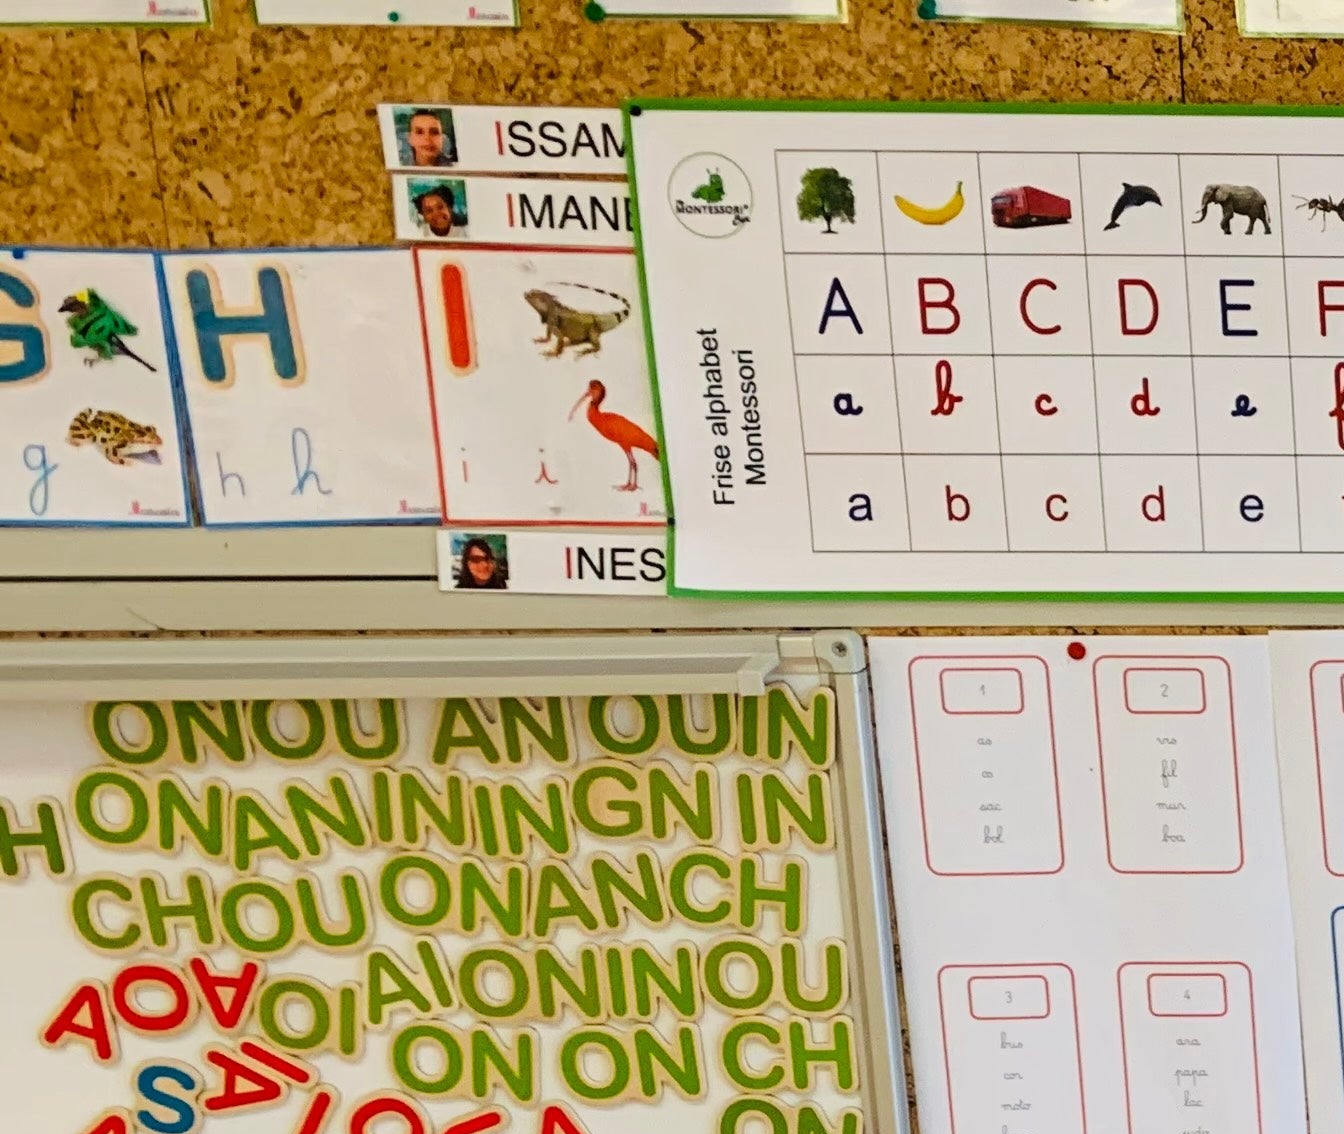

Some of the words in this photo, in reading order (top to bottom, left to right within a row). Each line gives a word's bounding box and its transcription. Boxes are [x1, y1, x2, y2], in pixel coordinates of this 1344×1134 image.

[495, 120, 626, 158] ISSAM
[186, 267, 298, 382] H
[818, 276, 864, 336] A
[917, 276, 961, 336] B
[1019, 277, 1063, 336] C
[1117, 278, 1160, 337] D
[1218, 278, 1259, 337] E
[696, 328, 731, 437] alphabet
[732, 349, 767, 486] Montessori
[711, 444, 735, 505] Frise
[564, 546, 667, 583] INES
[1159, 683, 1169, 698] 2
[1160, 758, 1178, 789] fil
[737, 773, 831, 845] IN
[983, 824, 1005, 845] bol
[1004, 990, 1013, 1004] 3
[393, 1024, 534, 1101] ON
[560, 1027, 702, 1100] ON
[722, 1018, 856, 1091] CH
[1173, 1067, 1209, 1086] papa
